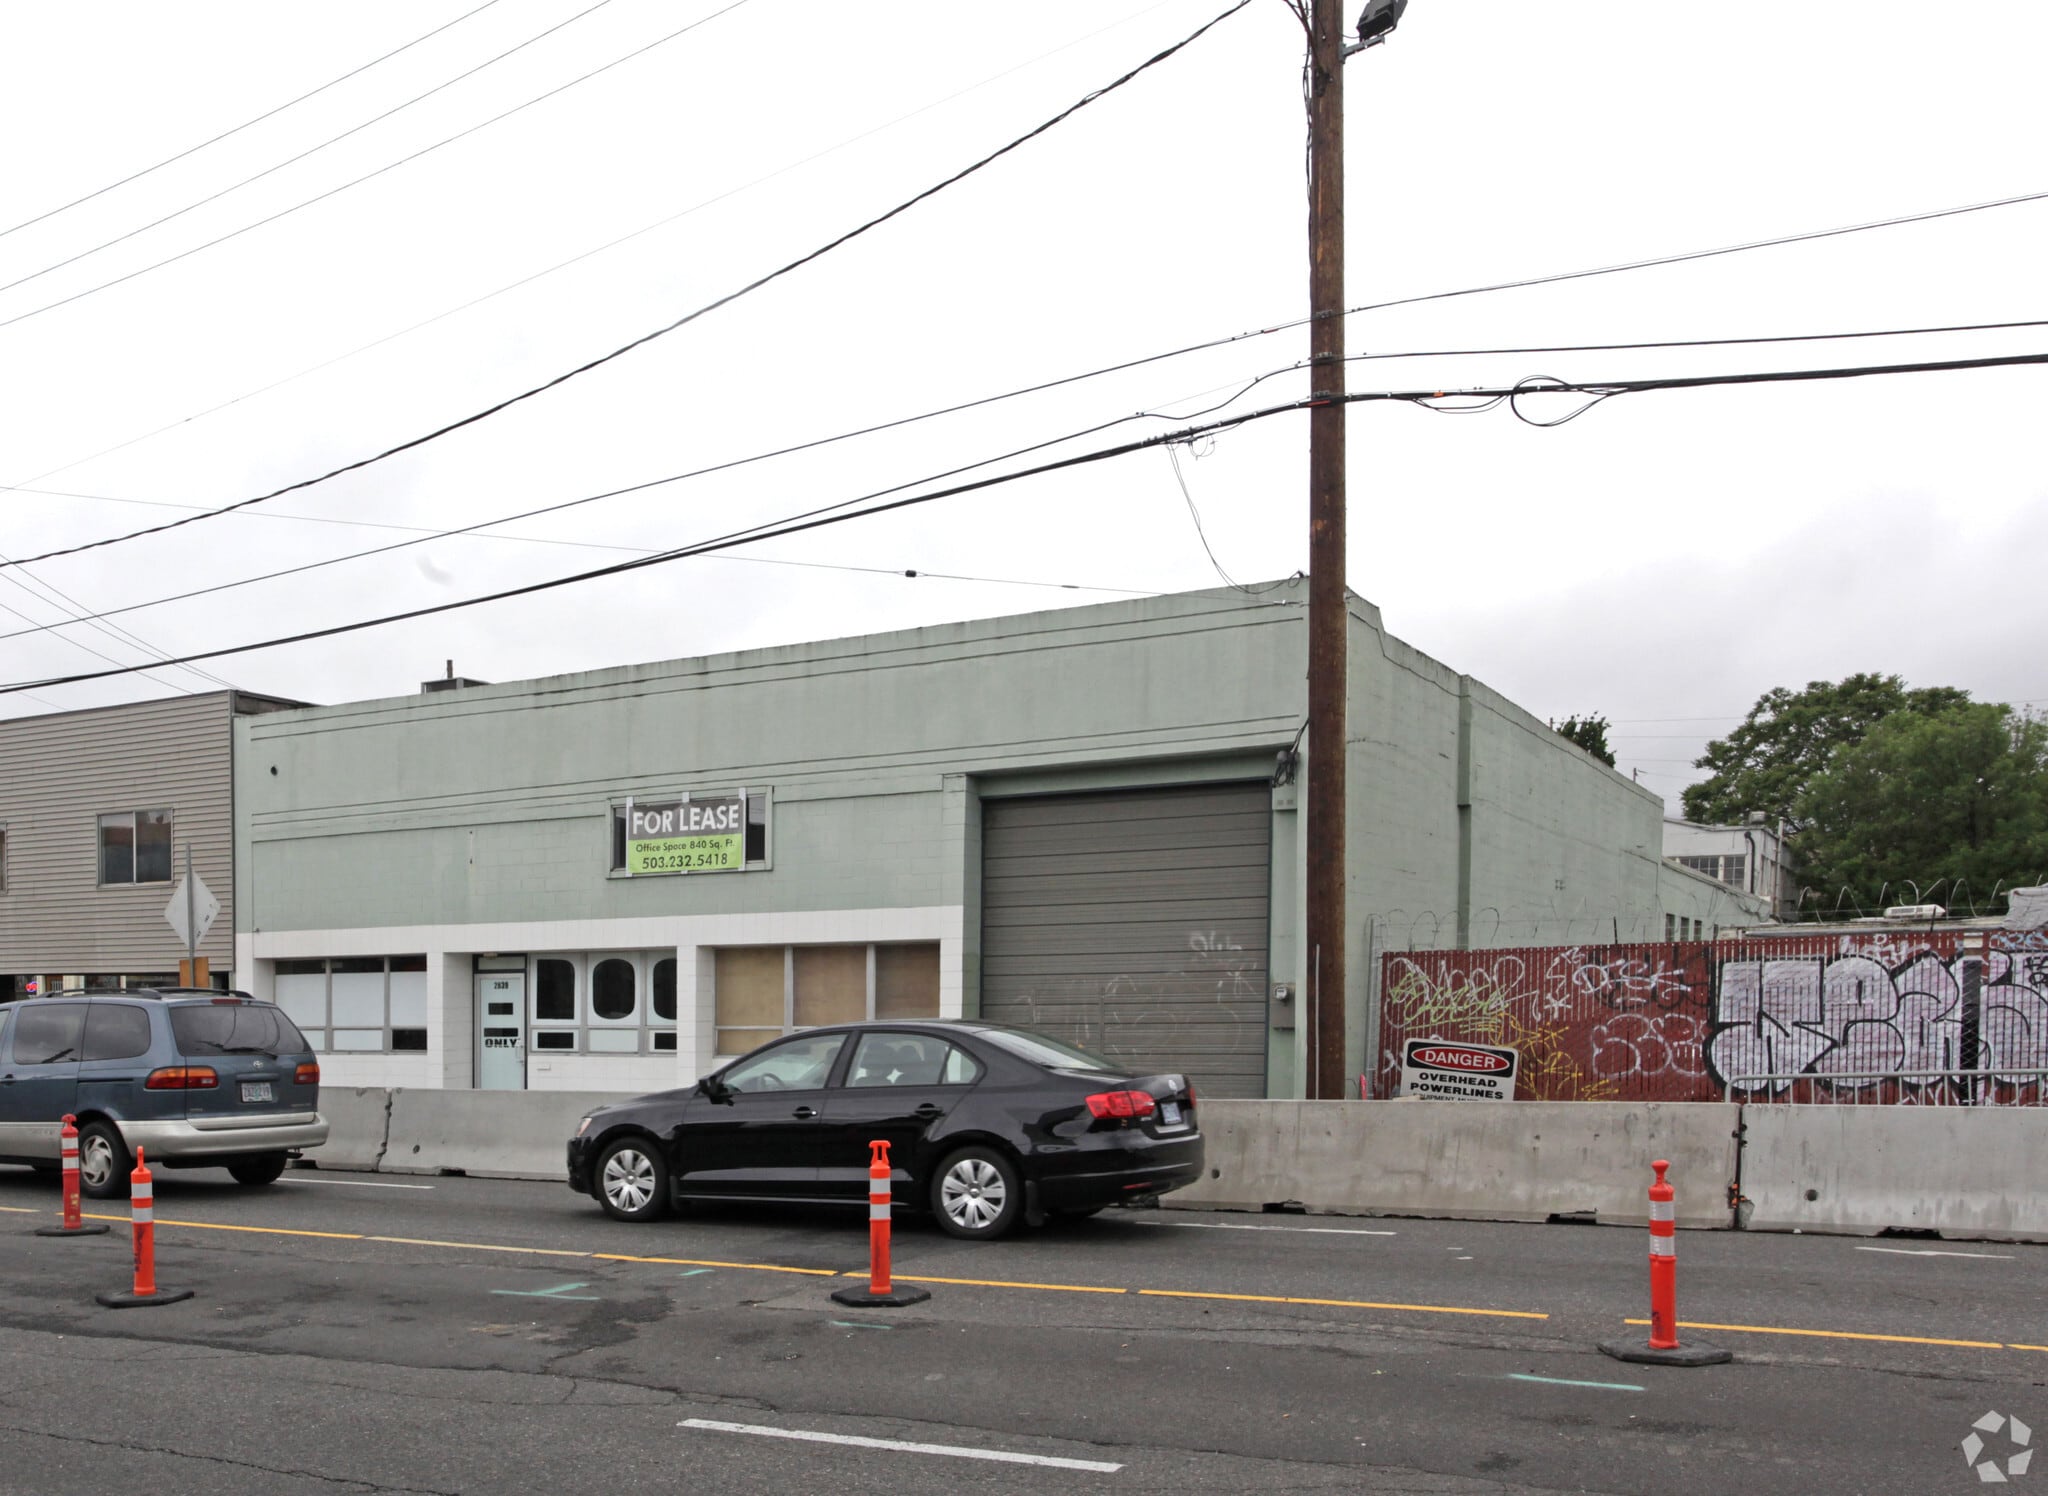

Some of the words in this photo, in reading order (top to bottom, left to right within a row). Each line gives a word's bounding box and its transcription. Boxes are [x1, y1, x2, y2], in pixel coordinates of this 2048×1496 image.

[632, 810, 673, 834] FOR
[679, 804, 739, 831] LEASE
[636, 843, 661, 853] Office
[663, 842, 687, 852] Space
[690, 840, 706, 849] 840
[709, 840, 722, 850] Sq.
[642, 853, 728, 869] 503.232.5418
[484, 1038, 517, 1048] ONLY
[1425, 1050, 1495, 1068] DANGER
[1419, 1072, 1497, 1087] OVERHEAD
[1410, 1082, 1504, 1099] POWERLINES
